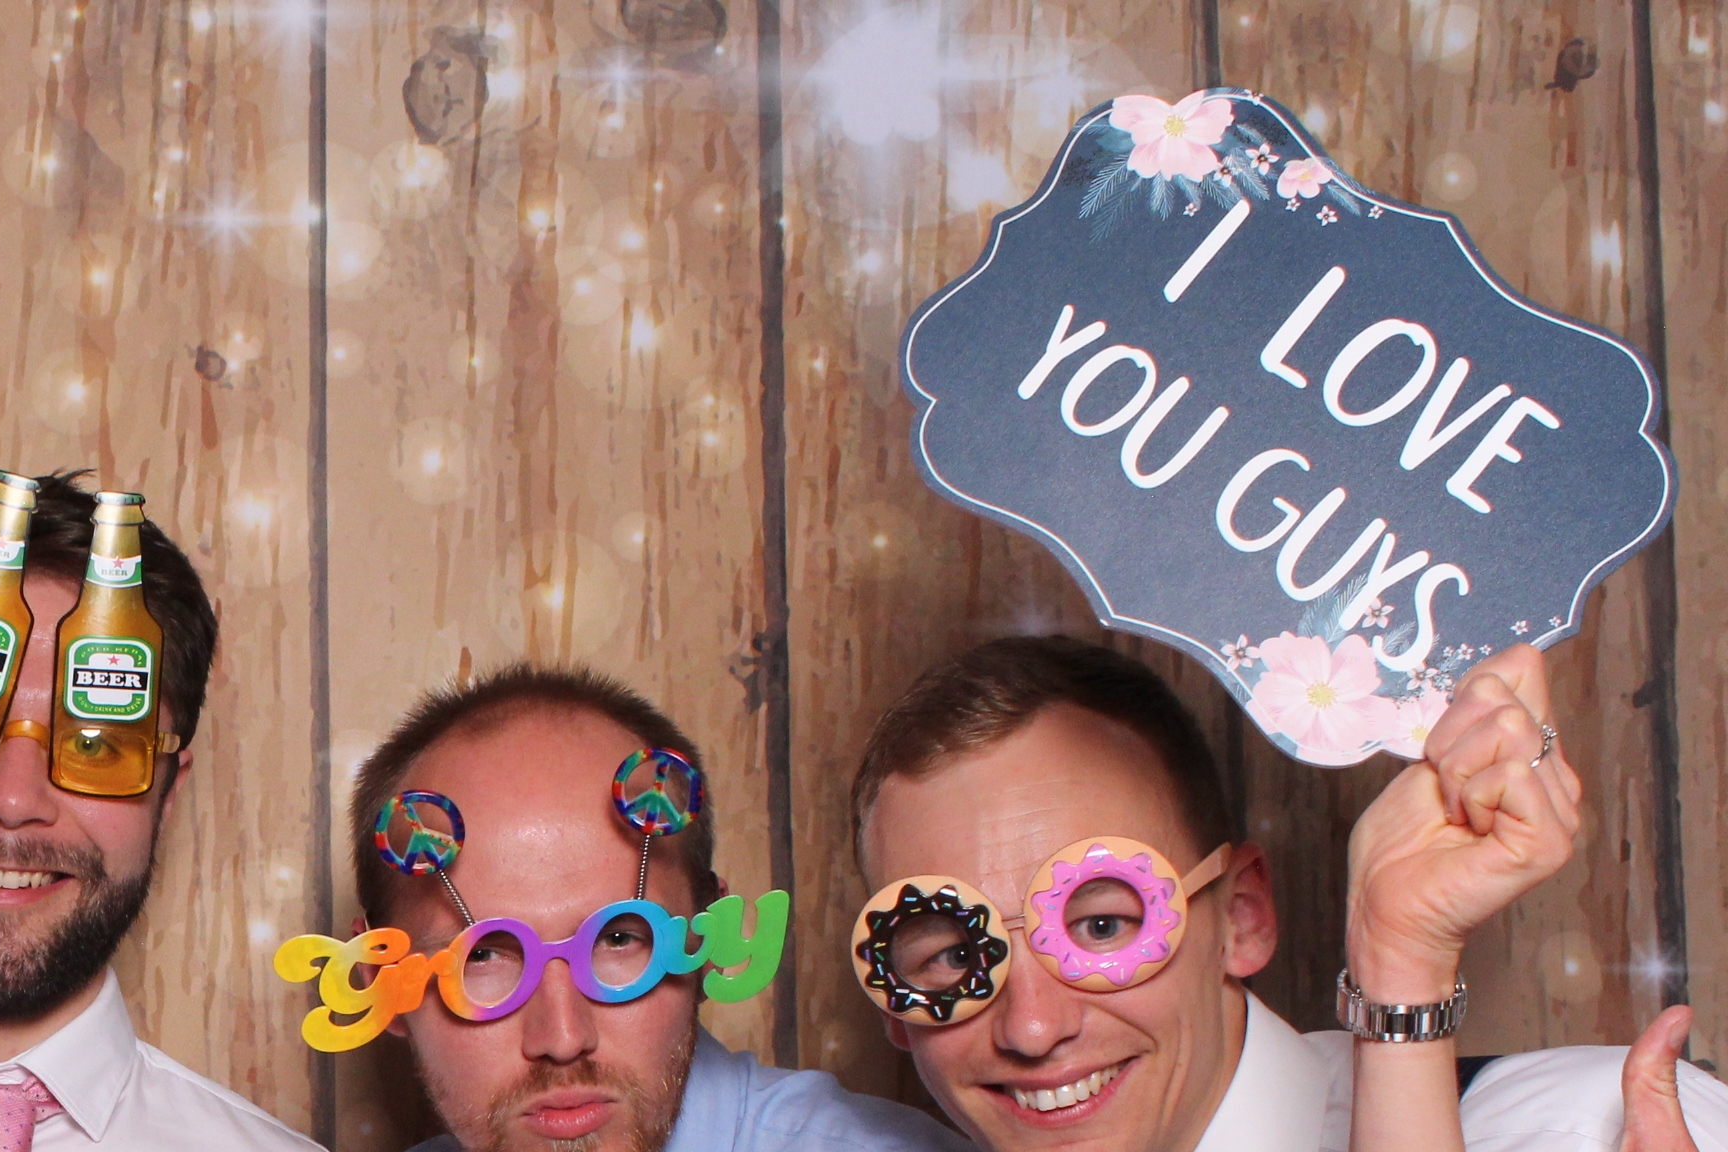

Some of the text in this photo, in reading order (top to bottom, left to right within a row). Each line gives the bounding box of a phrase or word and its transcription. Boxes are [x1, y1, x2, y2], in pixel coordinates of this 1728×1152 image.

[1164, 199, 1561, 515] I LOVE
[1017, 305, 1469, 672] YOU GUYS
[101, 569, 128, 577] BEER
[76, 670, 142, 688] BEER
